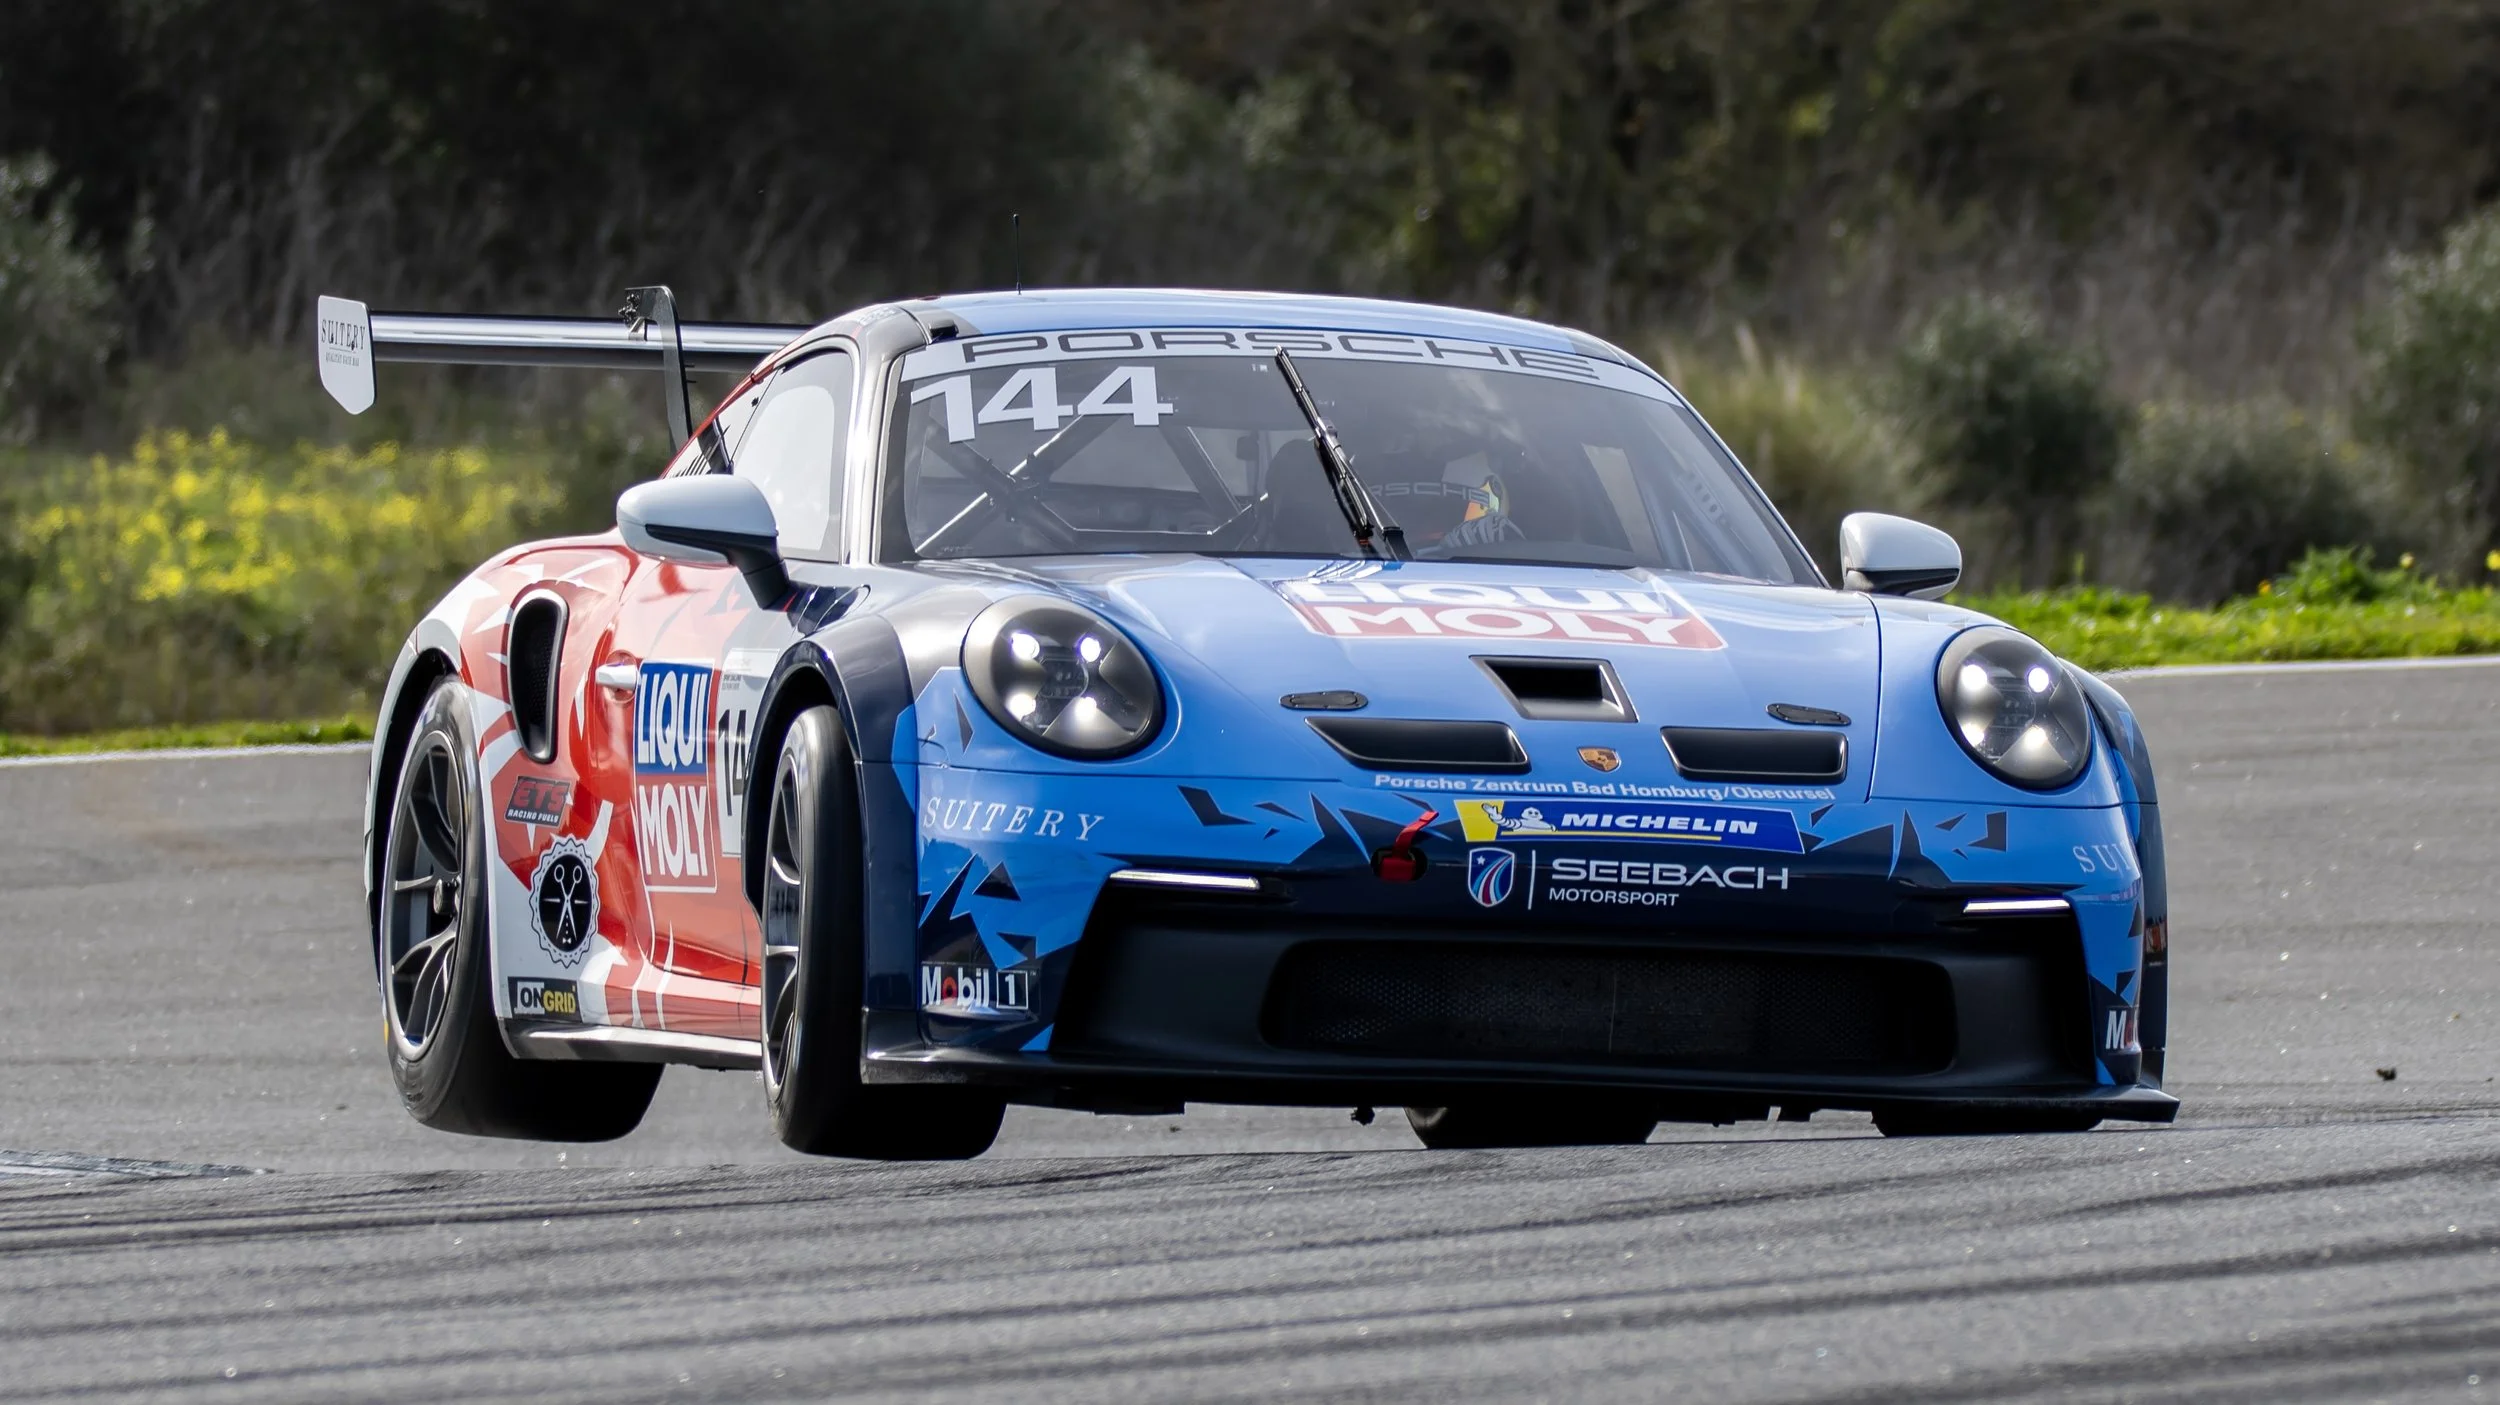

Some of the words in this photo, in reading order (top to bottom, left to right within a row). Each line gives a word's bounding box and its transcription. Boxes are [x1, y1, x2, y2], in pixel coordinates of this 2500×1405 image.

[321, 319, 366, 350] SUITERY
[961, 331, 1601, 381] PORSCHE
[910, 365, 1174, 443] 144
[1368, 481, 1490, 508] RSCHE
[1287, 581, 1671, 614] LIQUI
[1313, 606, 1691, 645] MOLY
[637, 670, 709, 772] LIQUI
[513, 780, 567, 812] ETS
[1375, 774, 1467, 790] Porsche
[1471, 777, 1568, 793] Zentrum
[1572, 782, 1616, 795] Bad
[1619, 783, 1836, 801] Homburg/Oberursel
[507, 808, 537, 820] RACING
[538, 813, 560, 823] FUELS
[638, 782, 709, 879] MOLY
[922, 796, 1105, 842] SUITERY
[1561, 813, 1758, 835] MICHELIN
[1551, 858, 1789, 890] SEEBACH
[1549, 887, 1680, 907] MOTORSPORT
[921, 965, 991, 1008] Mobil
